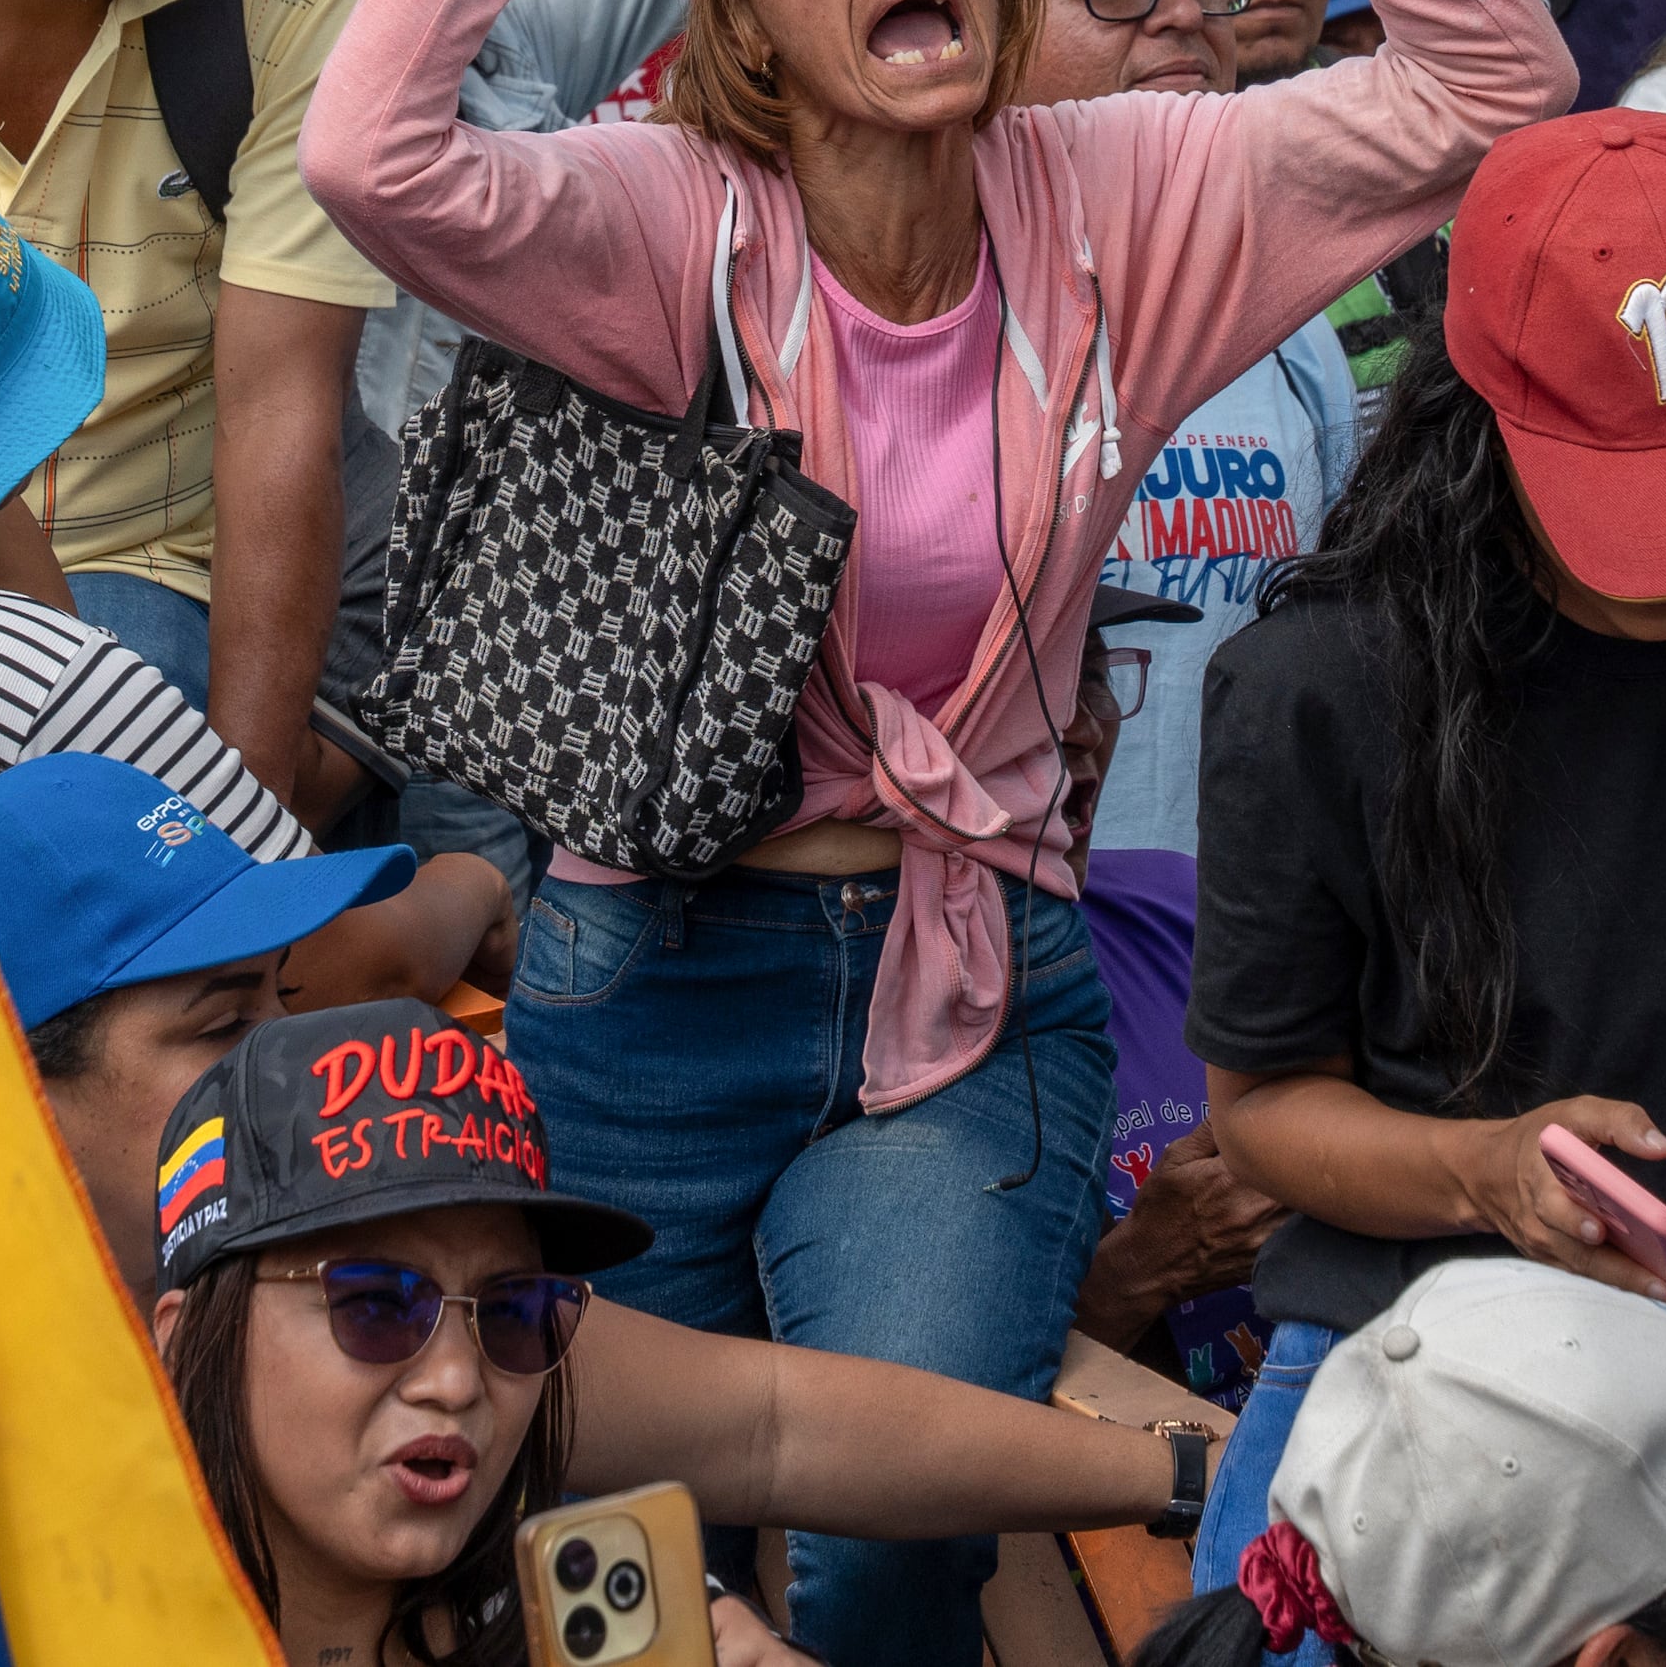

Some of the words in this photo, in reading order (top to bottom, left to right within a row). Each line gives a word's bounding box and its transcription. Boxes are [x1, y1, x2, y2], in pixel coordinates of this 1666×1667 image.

[1187, 433, 1209, 447] DE
[1216, 434, 1269, 448] ENERO
[1149, 498, 1299, 560] MADURO
[1113, 1100, 1155, 1142] pal
[1159, 1097, 1194, 1124] de
[311, 1118, 373, 1180] ES
